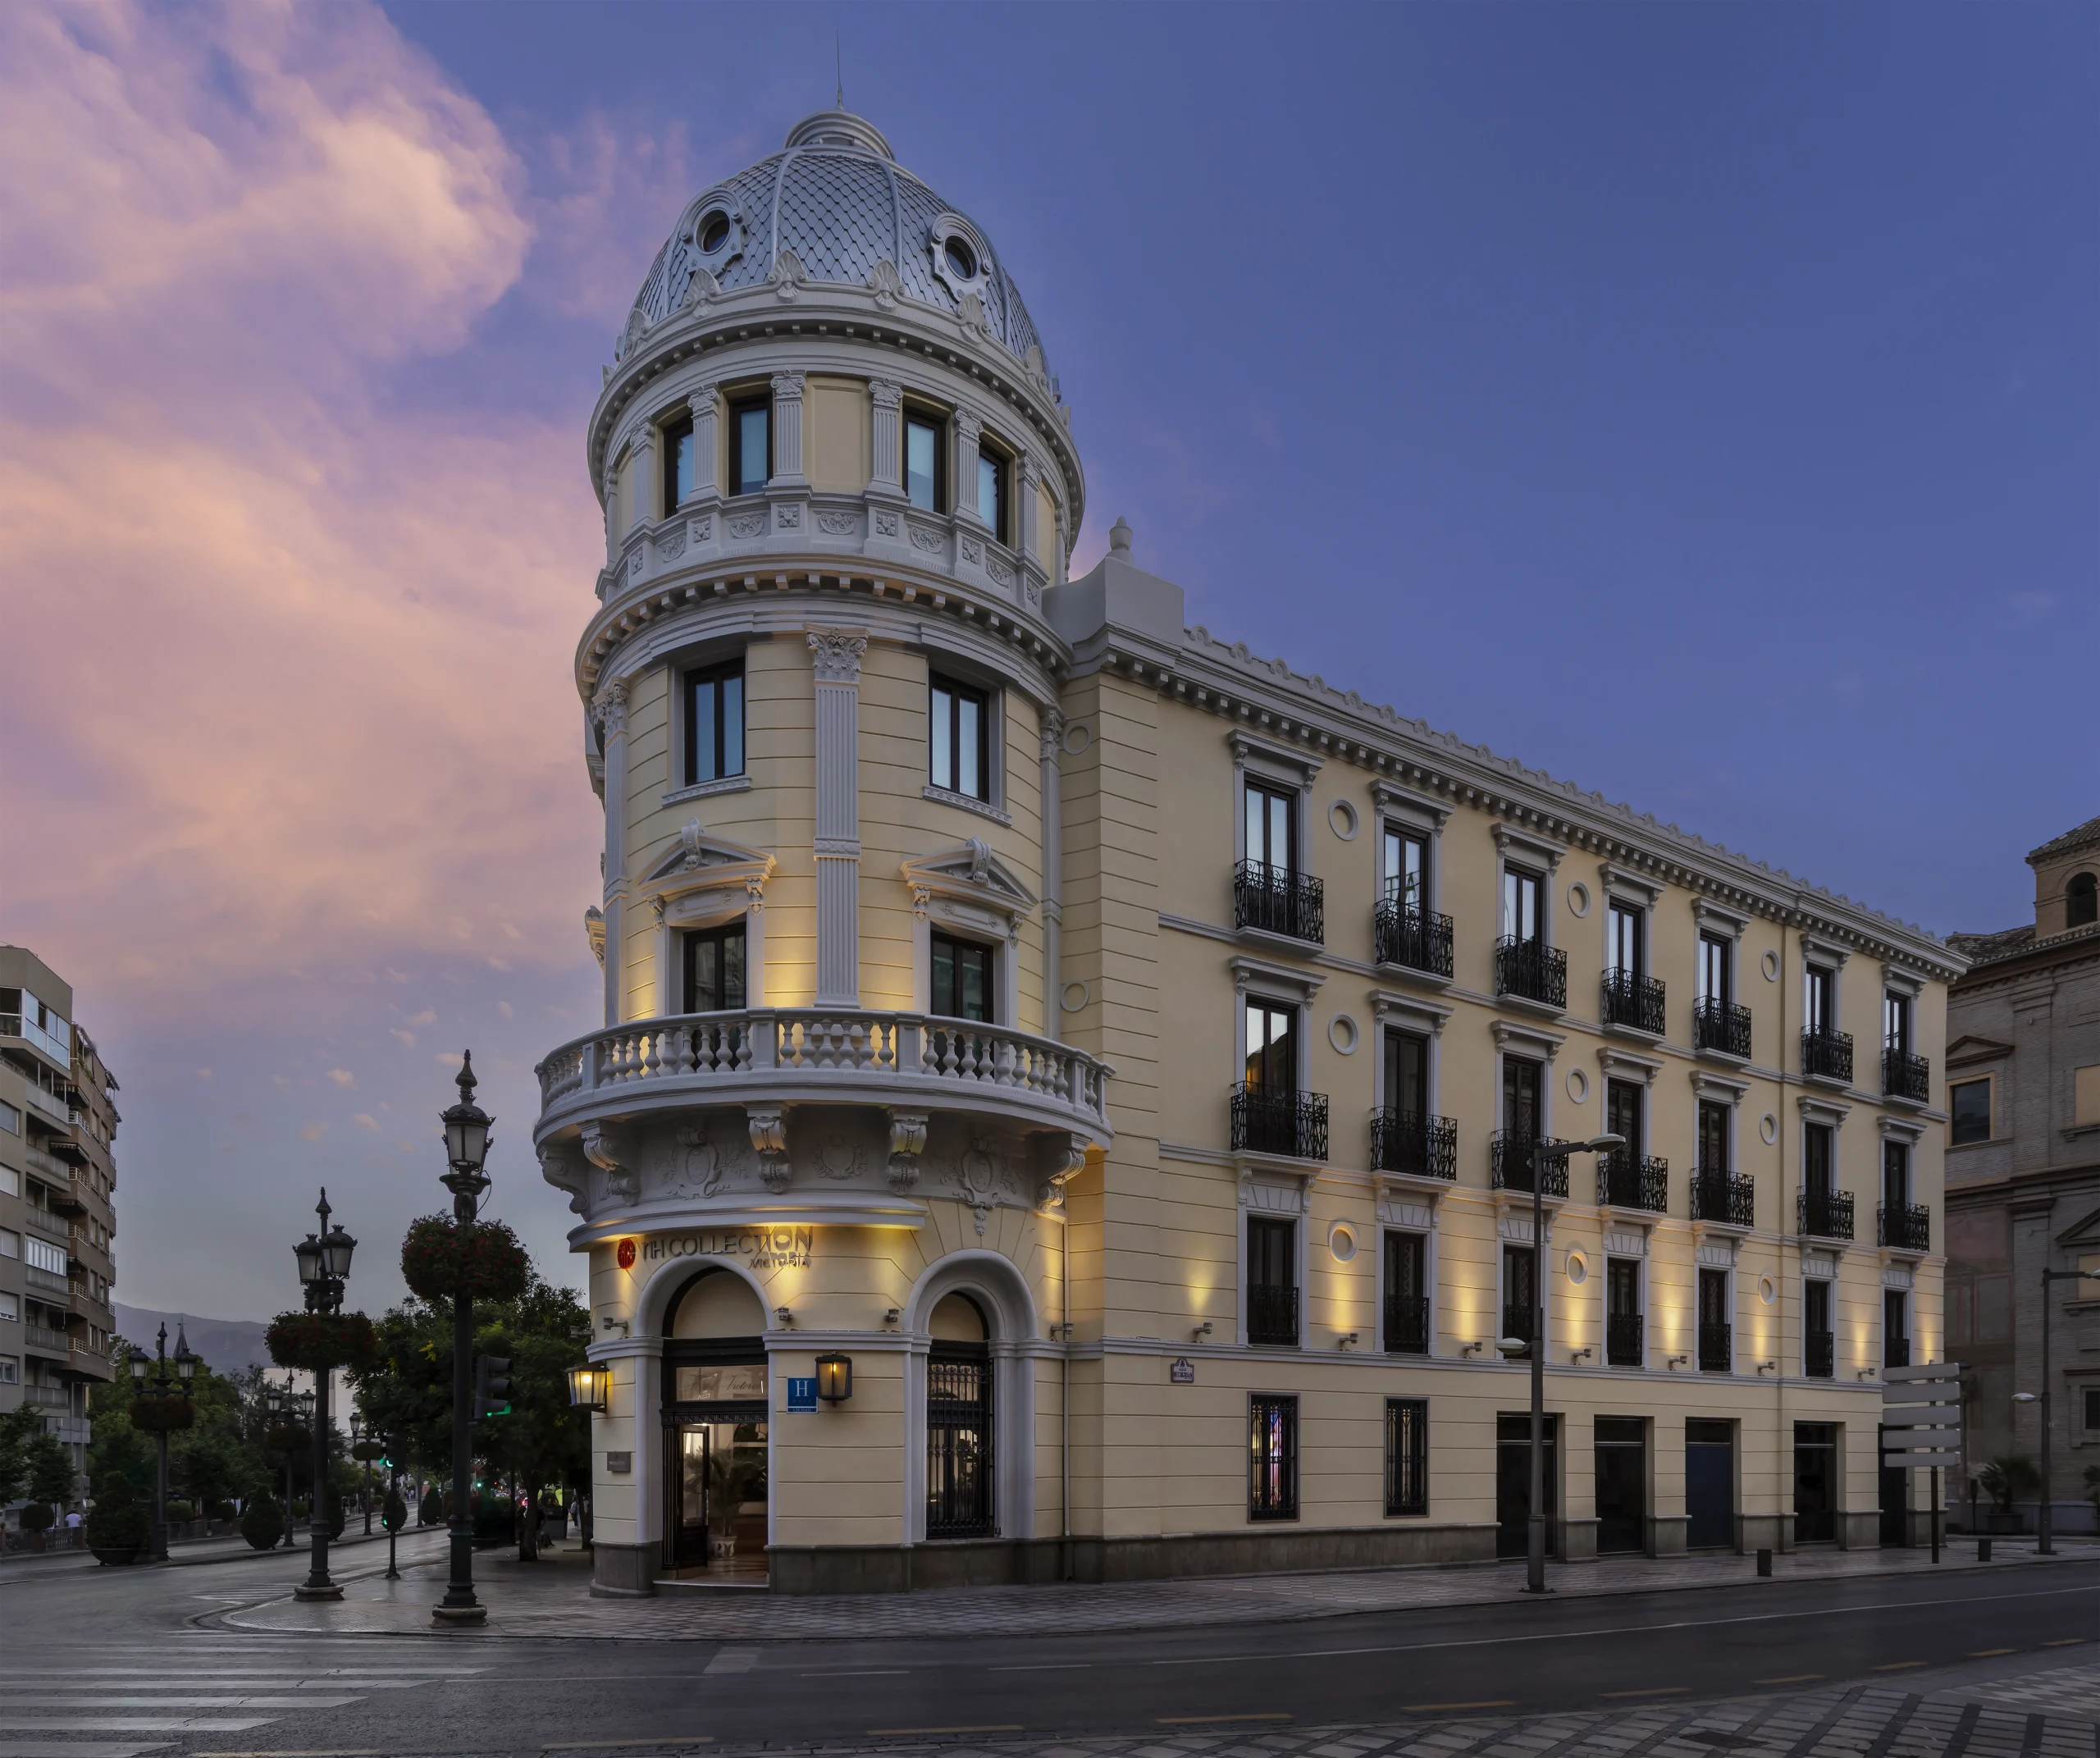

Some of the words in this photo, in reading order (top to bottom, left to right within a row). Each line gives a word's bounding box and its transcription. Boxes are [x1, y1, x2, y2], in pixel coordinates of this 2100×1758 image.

[669, 1233, 810, 1256] COLLECTION
[750, 1257, 810, 1268] VICTORIA
[796, 1380, 809, 1397] H
